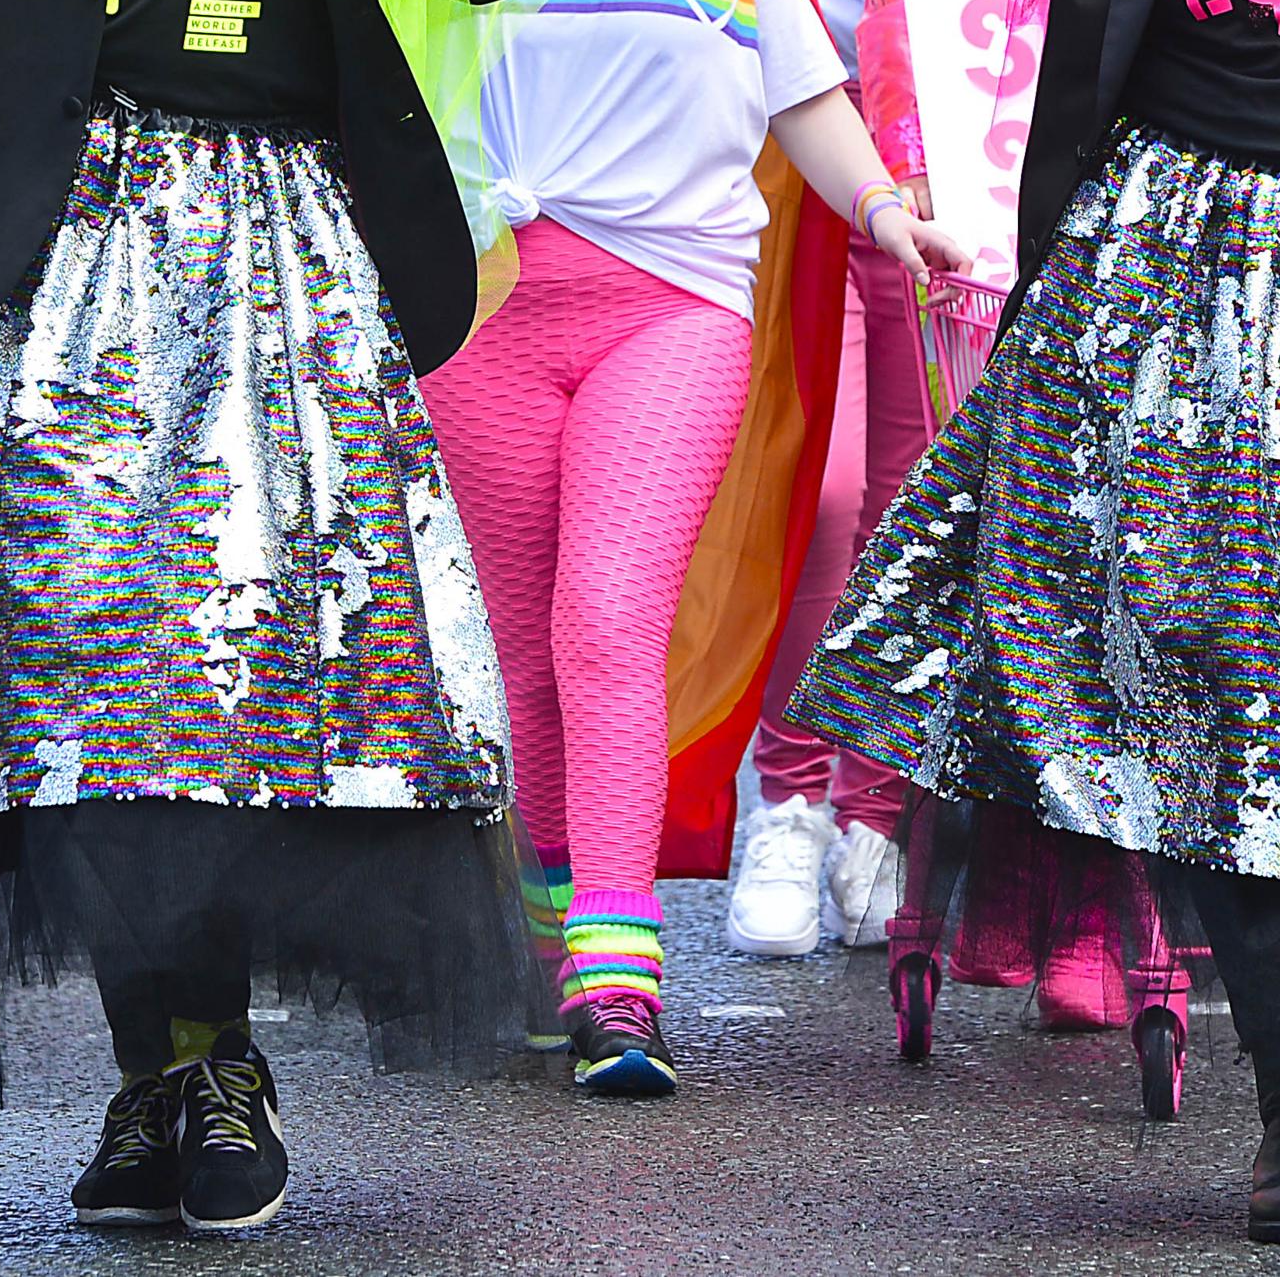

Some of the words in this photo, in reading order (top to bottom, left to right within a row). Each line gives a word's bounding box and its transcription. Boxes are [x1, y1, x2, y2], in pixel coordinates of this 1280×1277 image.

[194, 3, 253, 13] ANOTHER
[191, 20, 236, 31] WORLD
[188, 37, 242, 49] BELFAST
